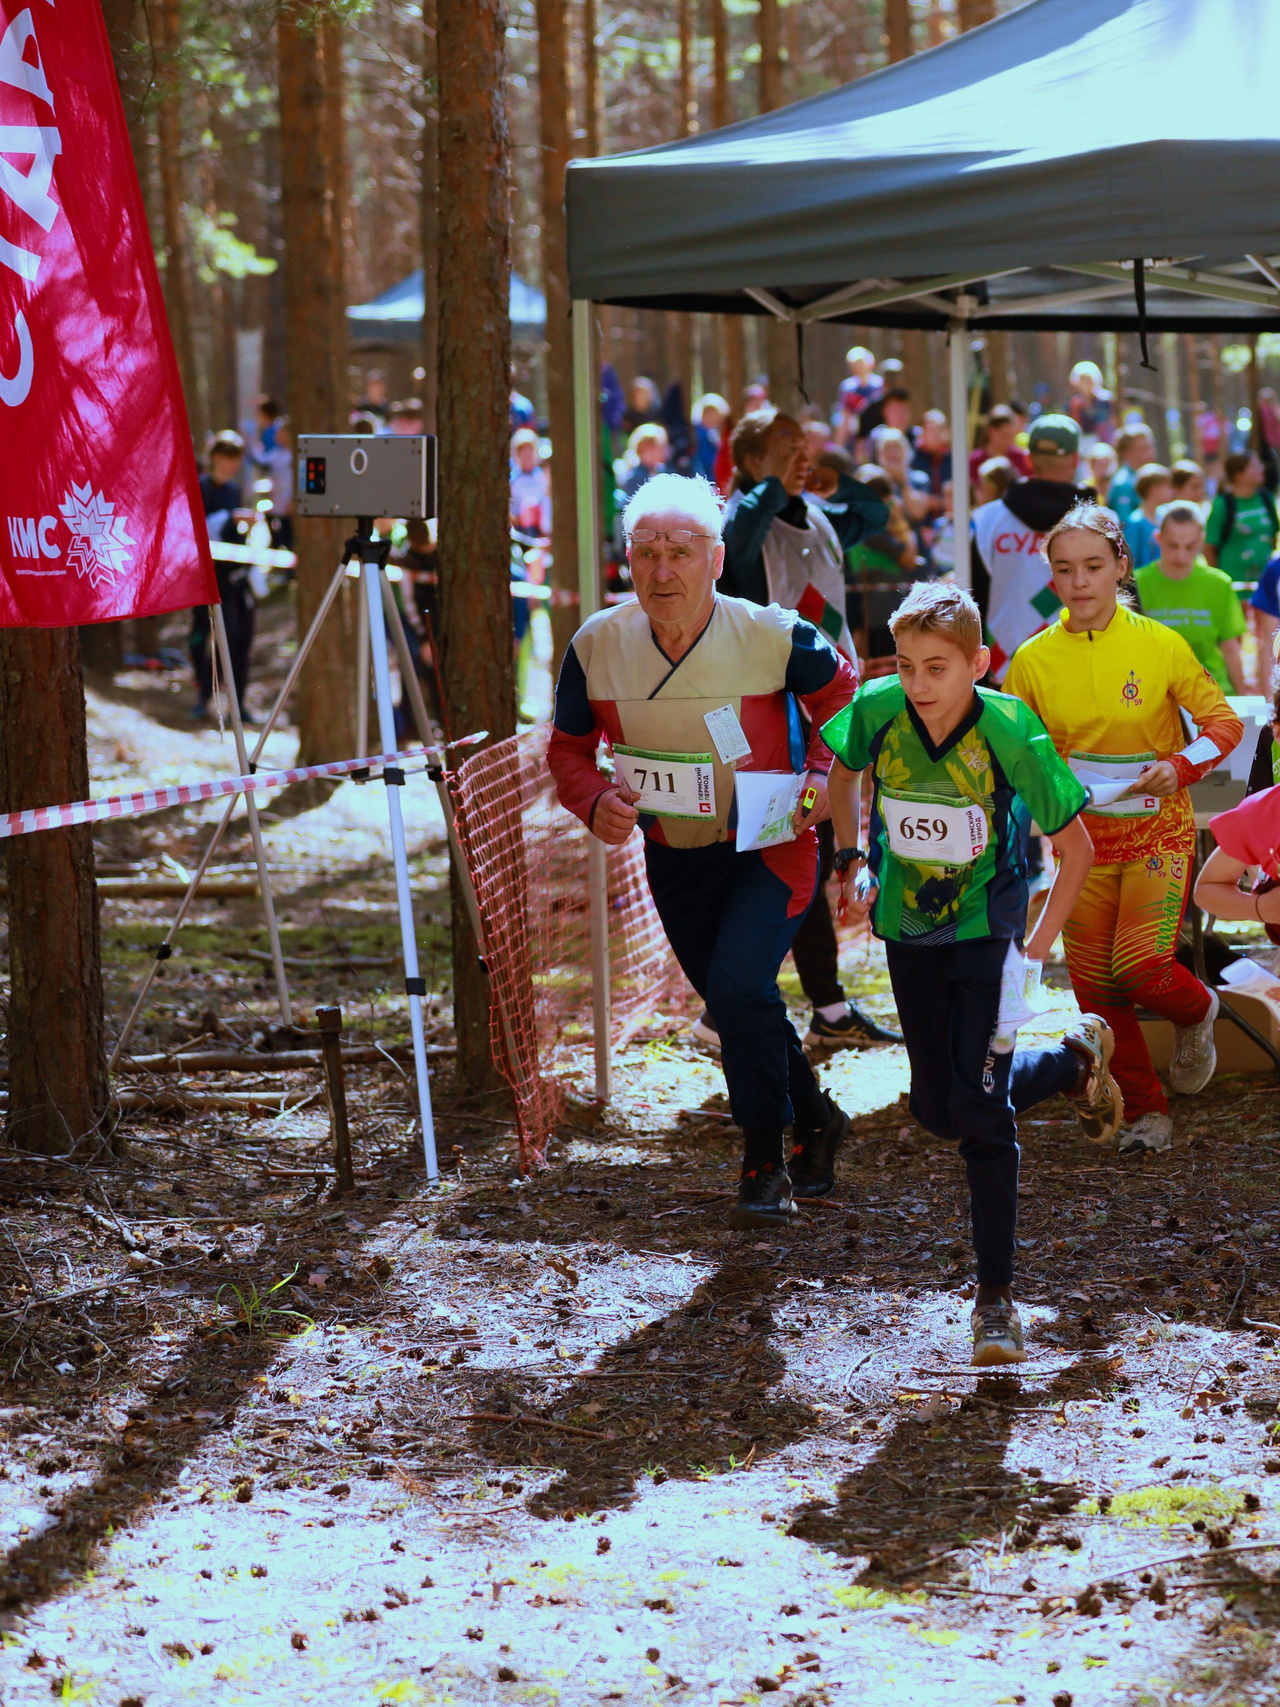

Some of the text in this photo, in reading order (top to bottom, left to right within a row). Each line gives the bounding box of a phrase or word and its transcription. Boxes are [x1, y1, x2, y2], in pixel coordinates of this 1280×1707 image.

[7, 515, 62, 559] КМС
[995, 532, 1046, 555] СУД
[1134, 698, 1143, 706] 59
[633, 768, 677, 794] 711
[695, 766, 704, 801] ПЕРМСКИЙ
[899, 816, 948, 842] 659
[966, 810, 977, 845] ПЕРМСКИЙ
[975, 816, 984, 843] ПЕРИОД
[1157, 870, 1167, 879] 59
